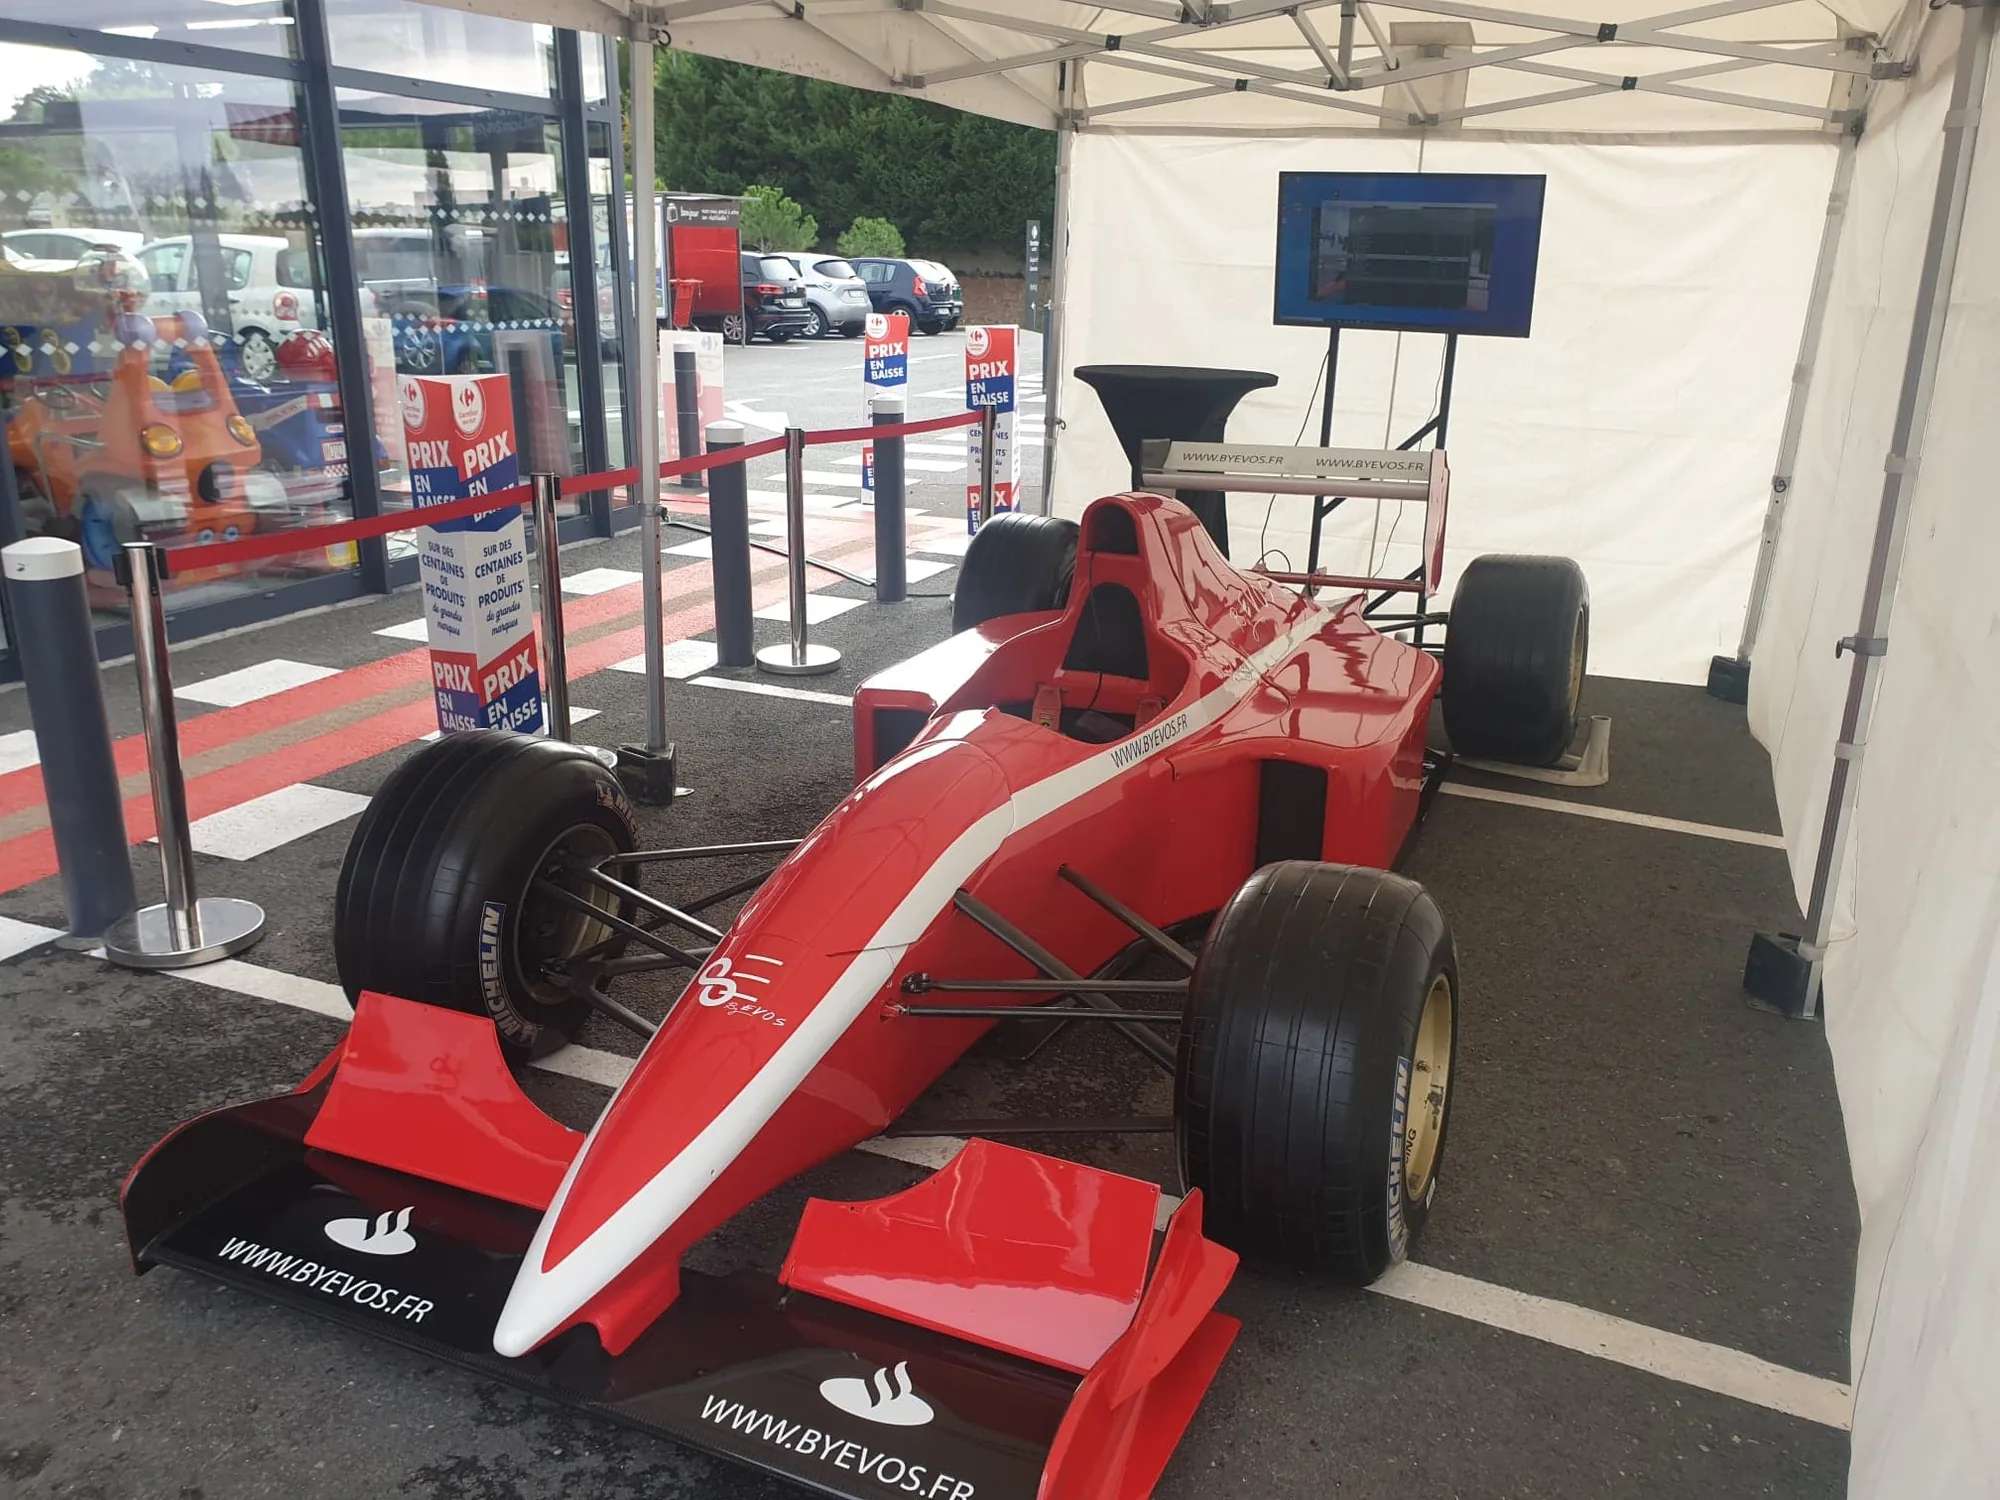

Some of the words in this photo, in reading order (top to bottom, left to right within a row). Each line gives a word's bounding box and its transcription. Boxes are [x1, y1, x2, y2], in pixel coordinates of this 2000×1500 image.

[869, 342, 904, 359] PRIX
[870, 360, 884, 370] EN
[871, 367, 904, 380] BAISSE
[968, 360, 1009, 380] PRIX
[971, 382, 986, 394] EN
[972, 391, 1009, 406] BAISSE
[408, 440, 453, 469] PRIX
[463, 431, 512, 478] PRIX
[1183, 452, 1284, 465] WWW.BYEVOS.FR
[1316, 458, 1424, 471] WWW.BYEVOS.FR
[414, 474, 431, 493] EN
[468, 477, 488, 497] EN
[428, 541, 440, 553] SUR
[442, 545, 454, 558] DES
[483, 545, 497, 557] SUR
[499, 539, 512, 552] DES
[421, 553, 464, 579] CENTAINES
[475, 551, 523, 578] CENTAINES
[440, 575, 448, 586] DE
[496, 574, 505, 585] DE
[495, 600, 520, 623] grandes
[433, 661, 475, 693] PRIX
[484, 648, 534, 703] PRIX
[438, 692, 453, 711] EN
[487, 697, 508, 724] EN
[441, 710, 476, 731] BAISSE
[1110, 713, 1188, 768] WWW.BYEVOS.FR
[481, 906, 521, 1036] MICHELIN
[1388, 1063, 1409, 1241] MICHELIN
[218, 1237, 434, 1323] WWW.BYEVOS.FR
[700, 1395, 975, 1500] WWW.BYEVOS.FR
